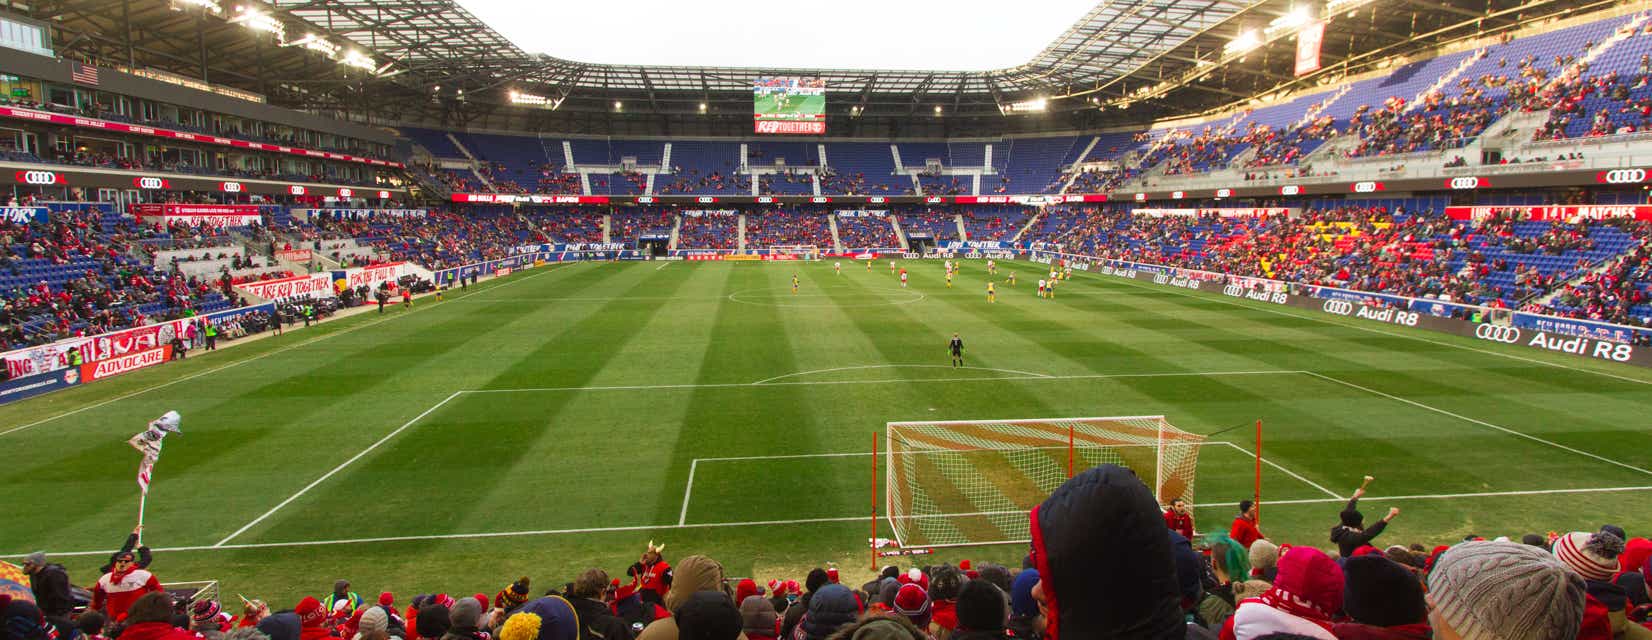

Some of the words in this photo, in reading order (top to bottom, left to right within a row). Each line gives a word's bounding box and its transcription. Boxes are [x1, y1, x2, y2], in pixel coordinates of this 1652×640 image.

[1113, 269, 1127, 278] Audi
[1170, 278, 1188, 288] Audi
[1188, 280, 1200, 289] R8
[261, 285, 277, 301] ARE
[278, 283, 293, 297] RED
[294, 276, 330, 296] TOGETHER
[1245, 289, 1271, 302] Audi
[1271, 293, 1288, 304] R8
[1356, 305, 1393, 323] Audi
[1394, 311, 1420, 327] R8
[1528, 332, 1590, 355] Audi
[1593, 341, 1633, 362] R8
[93, 348, 164, 379] ADVOCARE
